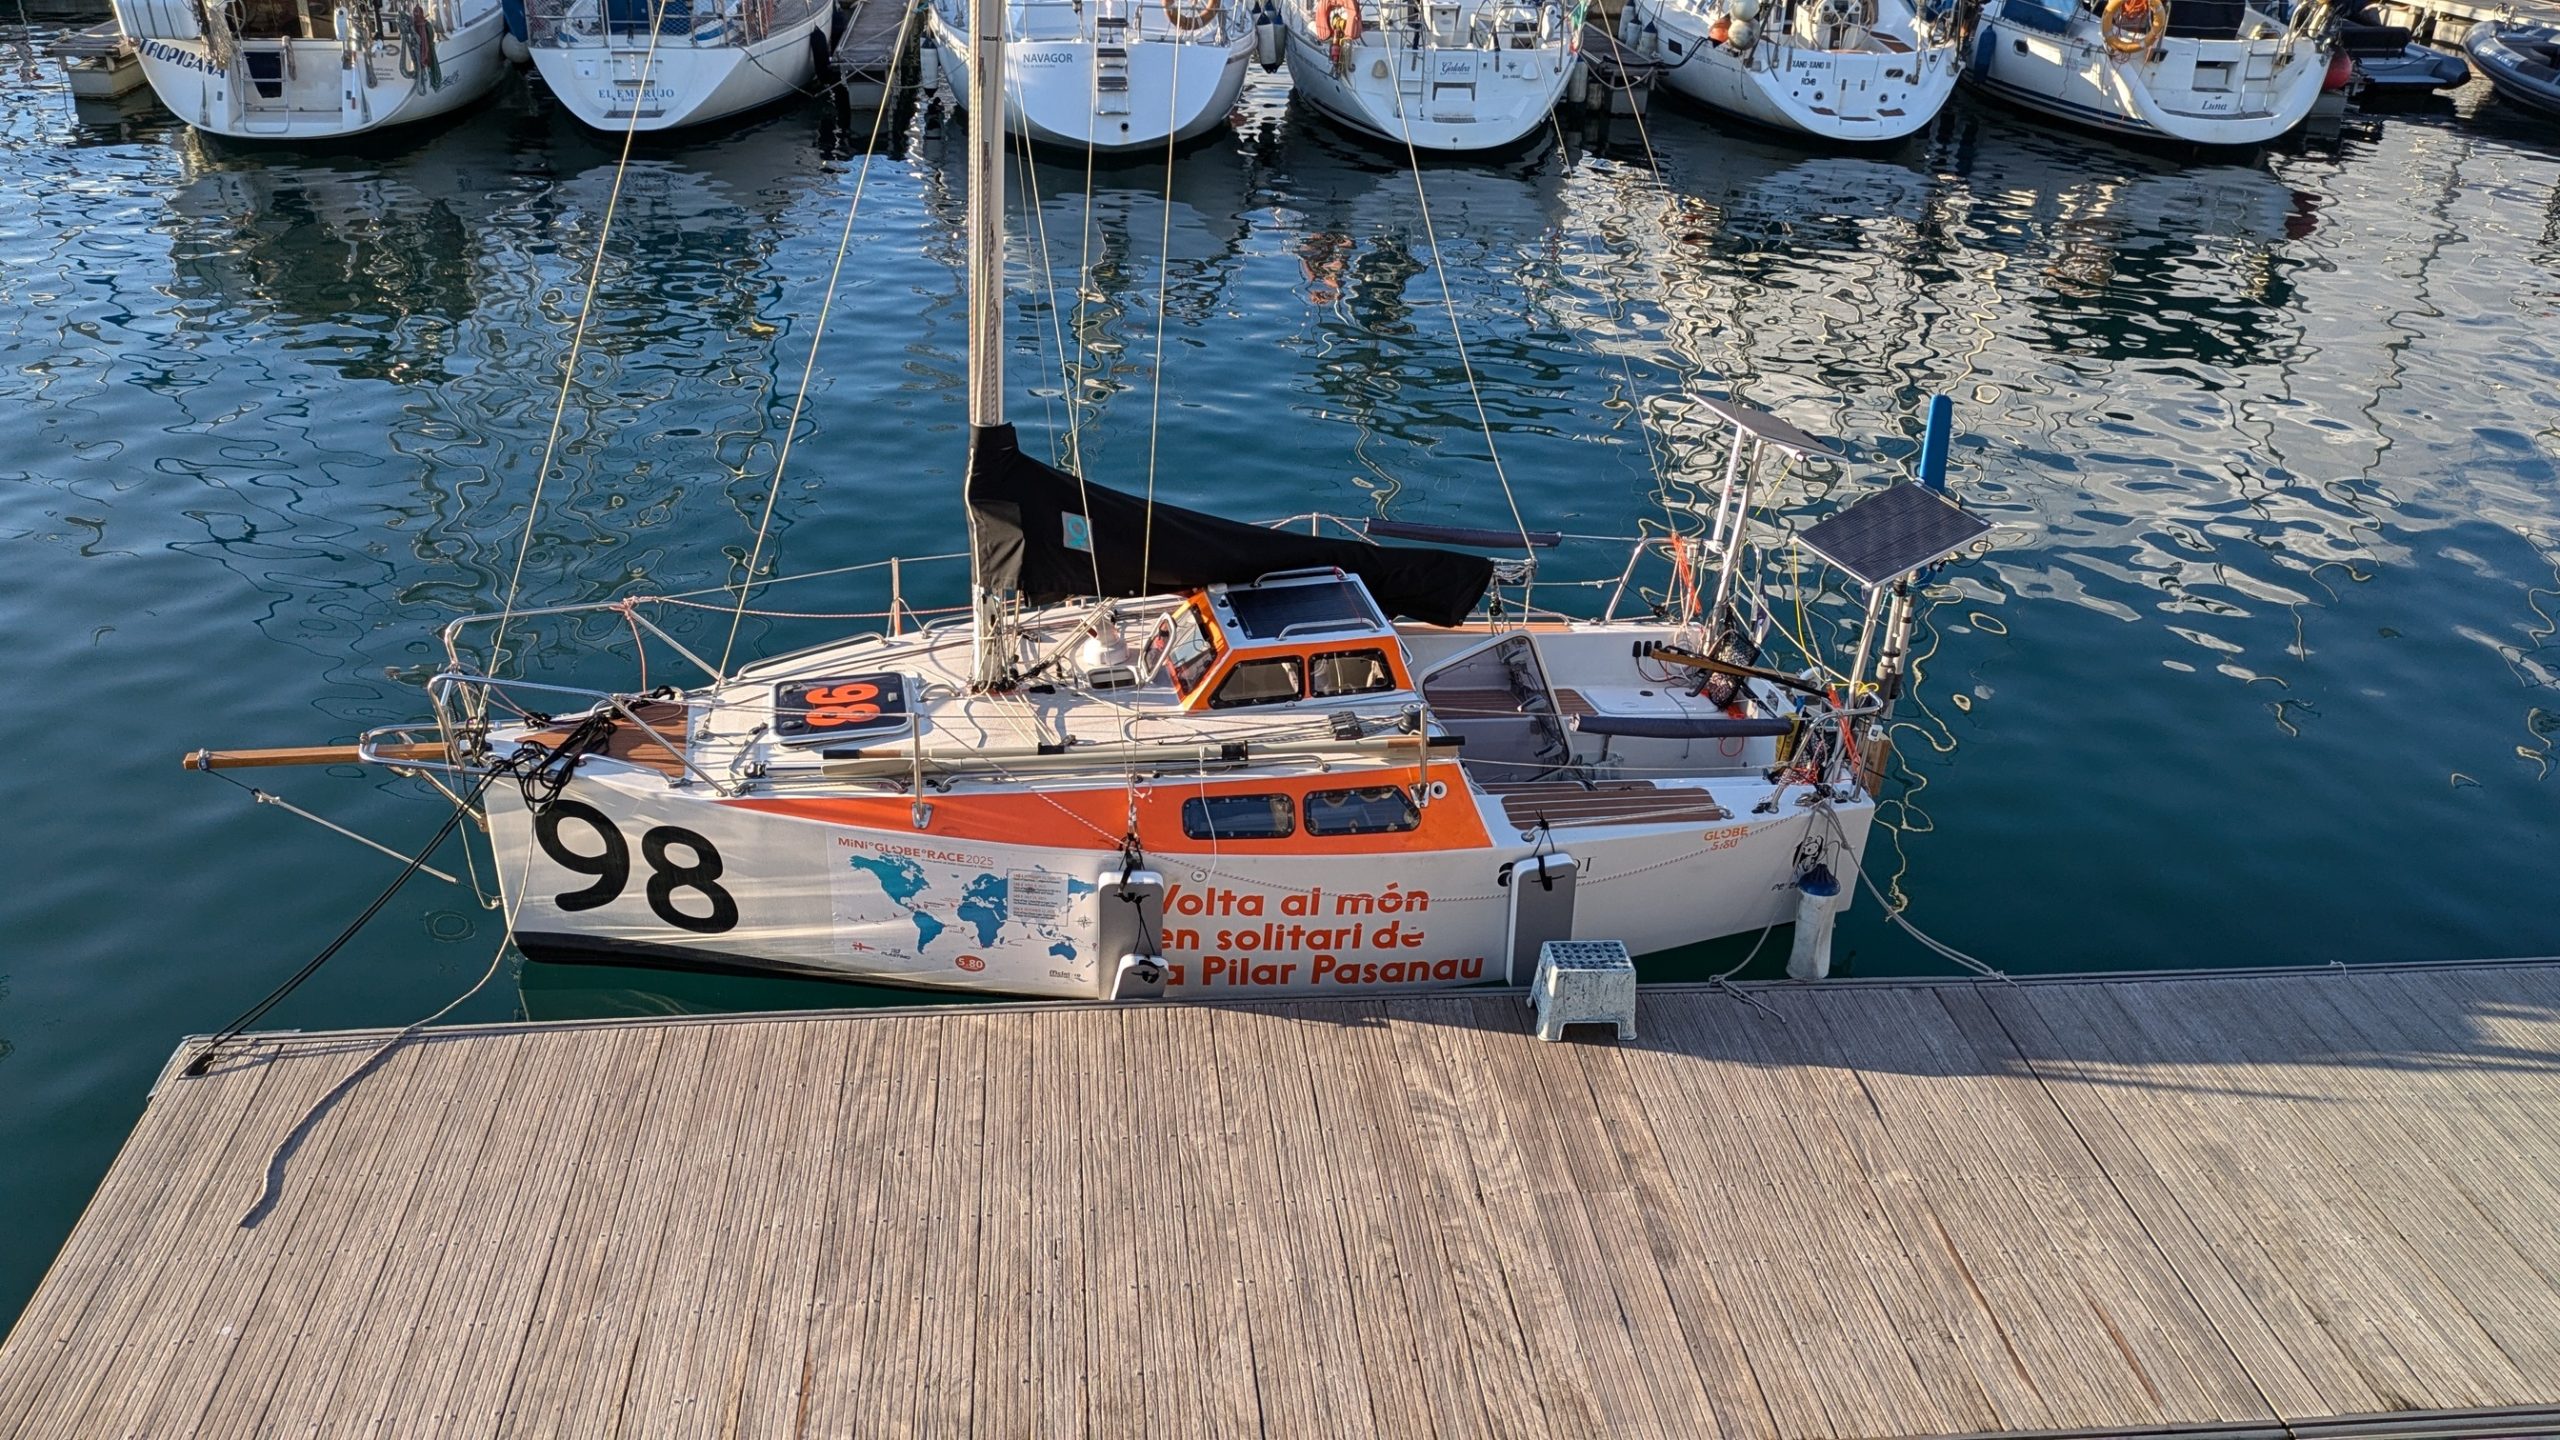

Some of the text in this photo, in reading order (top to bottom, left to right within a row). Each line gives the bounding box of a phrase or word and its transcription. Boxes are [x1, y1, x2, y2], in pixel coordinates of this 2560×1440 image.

[1022, 53, 1073, 63] NAVAGOR
[598, 89, 613, 98] EL
[2201, 100, 2228, 110] Luna
[1703, 826, 1749, 841] GLOBE
[534, 799, 739, 934] 98
[966, 854, 994, 866] 2025
[1336, 882, 1429, 915] món
[1216, 922, 1363, 951] solitari
[1202, 955, 1296, 985] Pilar
[1311, 954, 1483, 984] Pasanau
